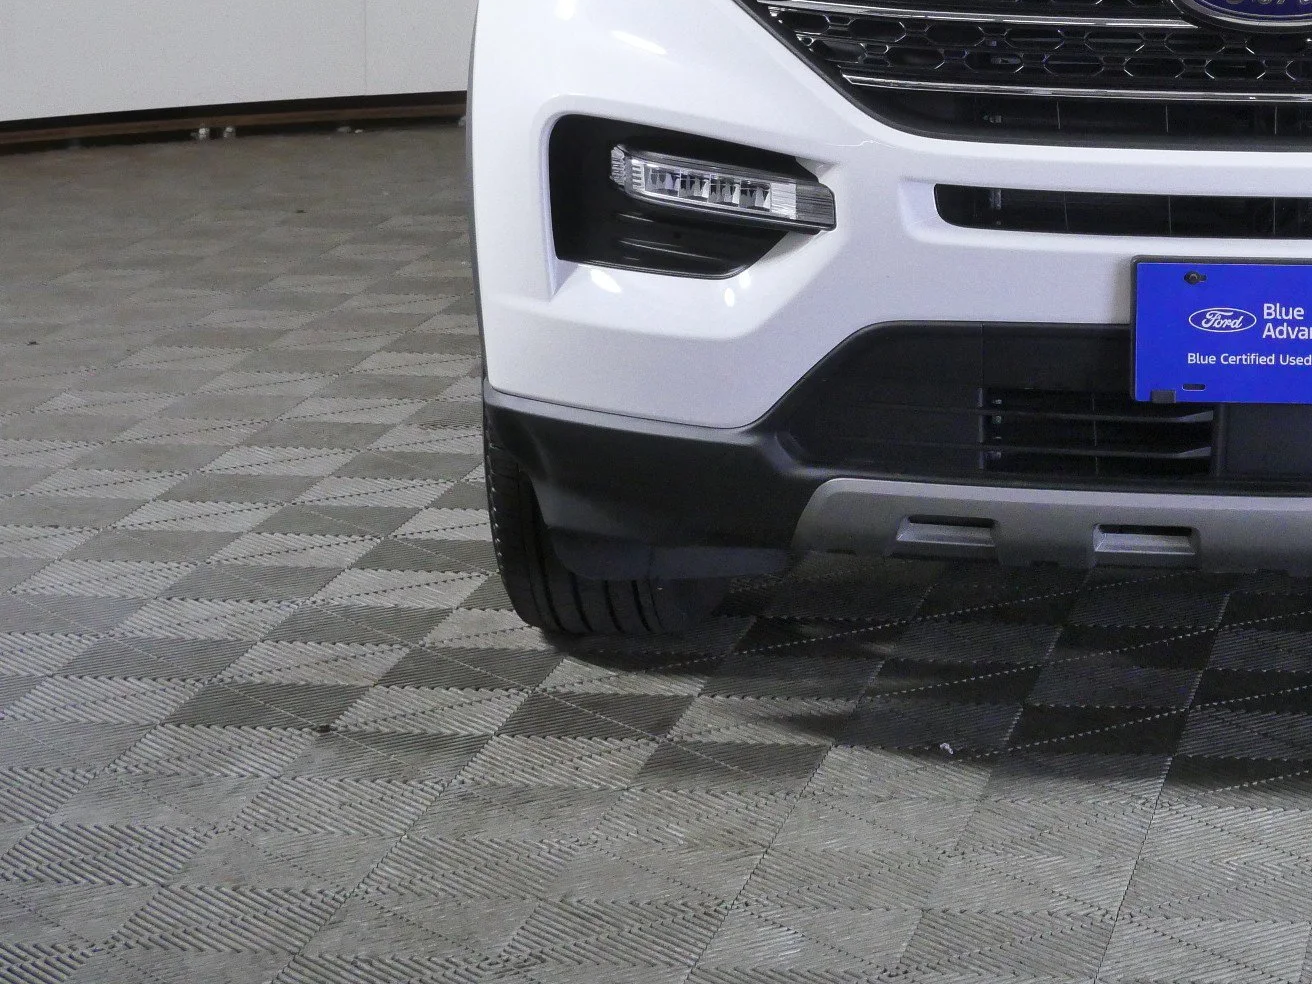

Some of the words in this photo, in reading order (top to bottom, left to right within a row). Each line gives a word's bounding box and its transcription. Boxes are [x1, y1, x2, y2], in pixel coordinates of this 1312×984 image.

[1201, 310, 1243, 329] Ford
[1263, 303, 1305, 320] Blue
[1187, 353, 1216, 365] Blue
[1220, 353, 1275, 366] Certified
[1279, 354, 1312, 366] Used
